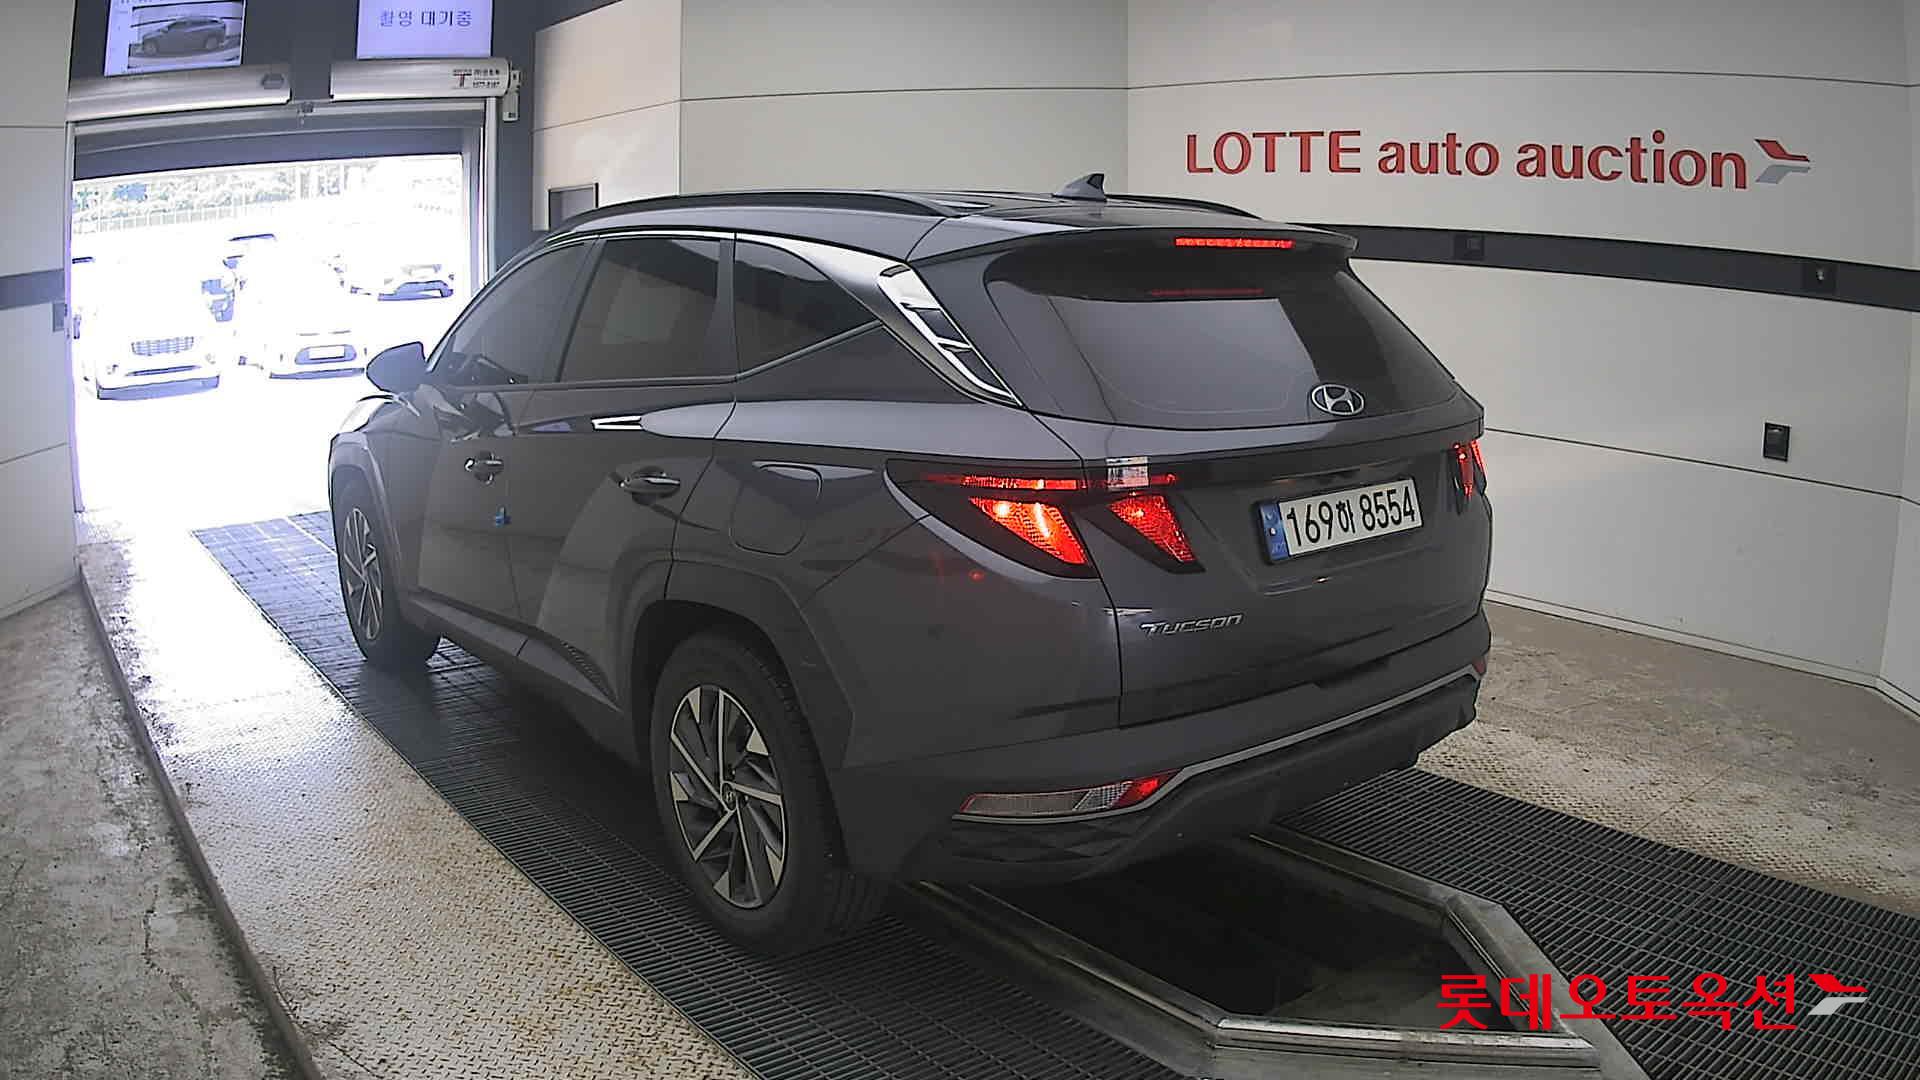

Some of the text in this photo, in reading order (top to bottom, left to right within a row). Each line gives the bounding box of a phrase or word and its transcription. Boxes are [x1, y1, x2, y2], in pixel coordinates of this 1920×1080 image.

[420, 10, 473, 27] 대기중
[1187, 131, 1747, 189] LOTTE auto auction
[1286, 486, 1416, 547] 169하 8554
